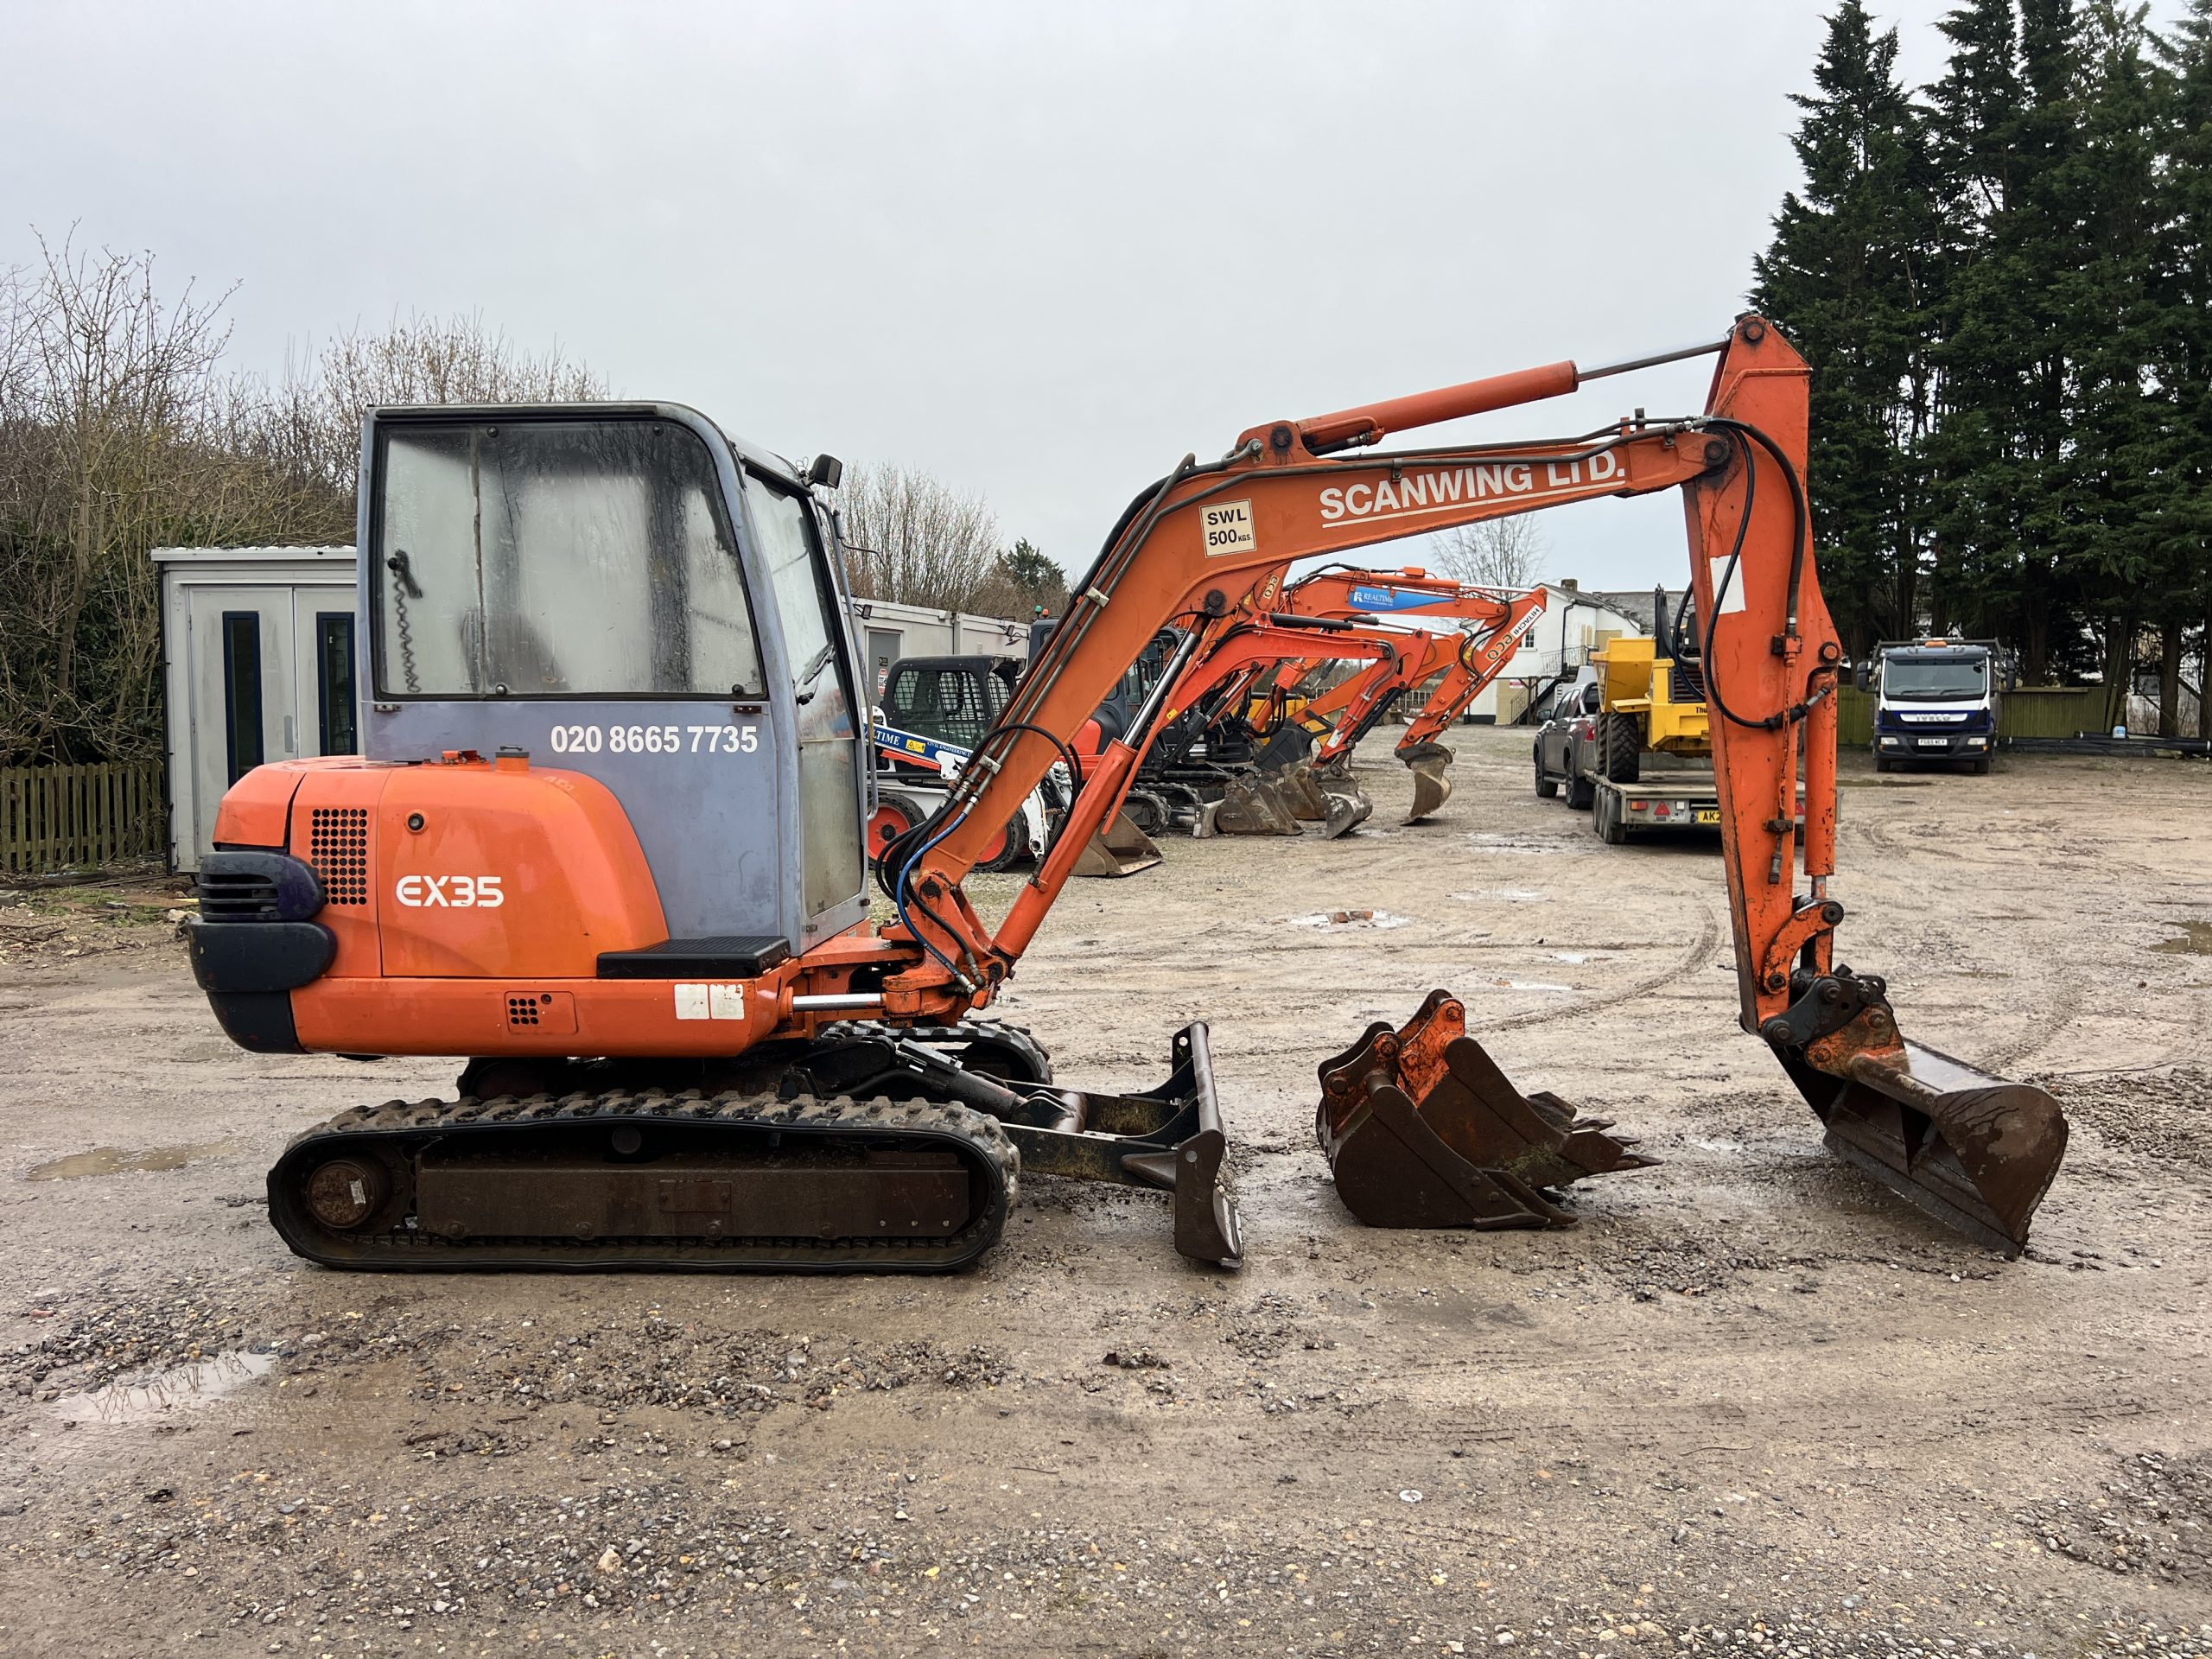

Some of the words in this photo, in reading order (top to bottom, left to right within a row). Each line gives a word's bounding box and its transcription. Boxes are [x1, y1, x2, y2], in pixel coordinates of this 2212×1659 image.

[1319, 463, 1533, 519] SCANWING
[1548, 448, 1625, 487] LTD.
[1207, 508, 1247, 525] SWL
[1209, 529, 1237, 546] 500
[1363, 592, 1393, 603] REALTIME
[1513, 607, 1540, 635] HITACHI
[1487, 633, 1513, 660] eco
[550, 725, 602, 753] 020
[609, 725, 680, 753] 8665
[687, 725, 758, 753] 7735
[395, 874, 505, 908] EX35
